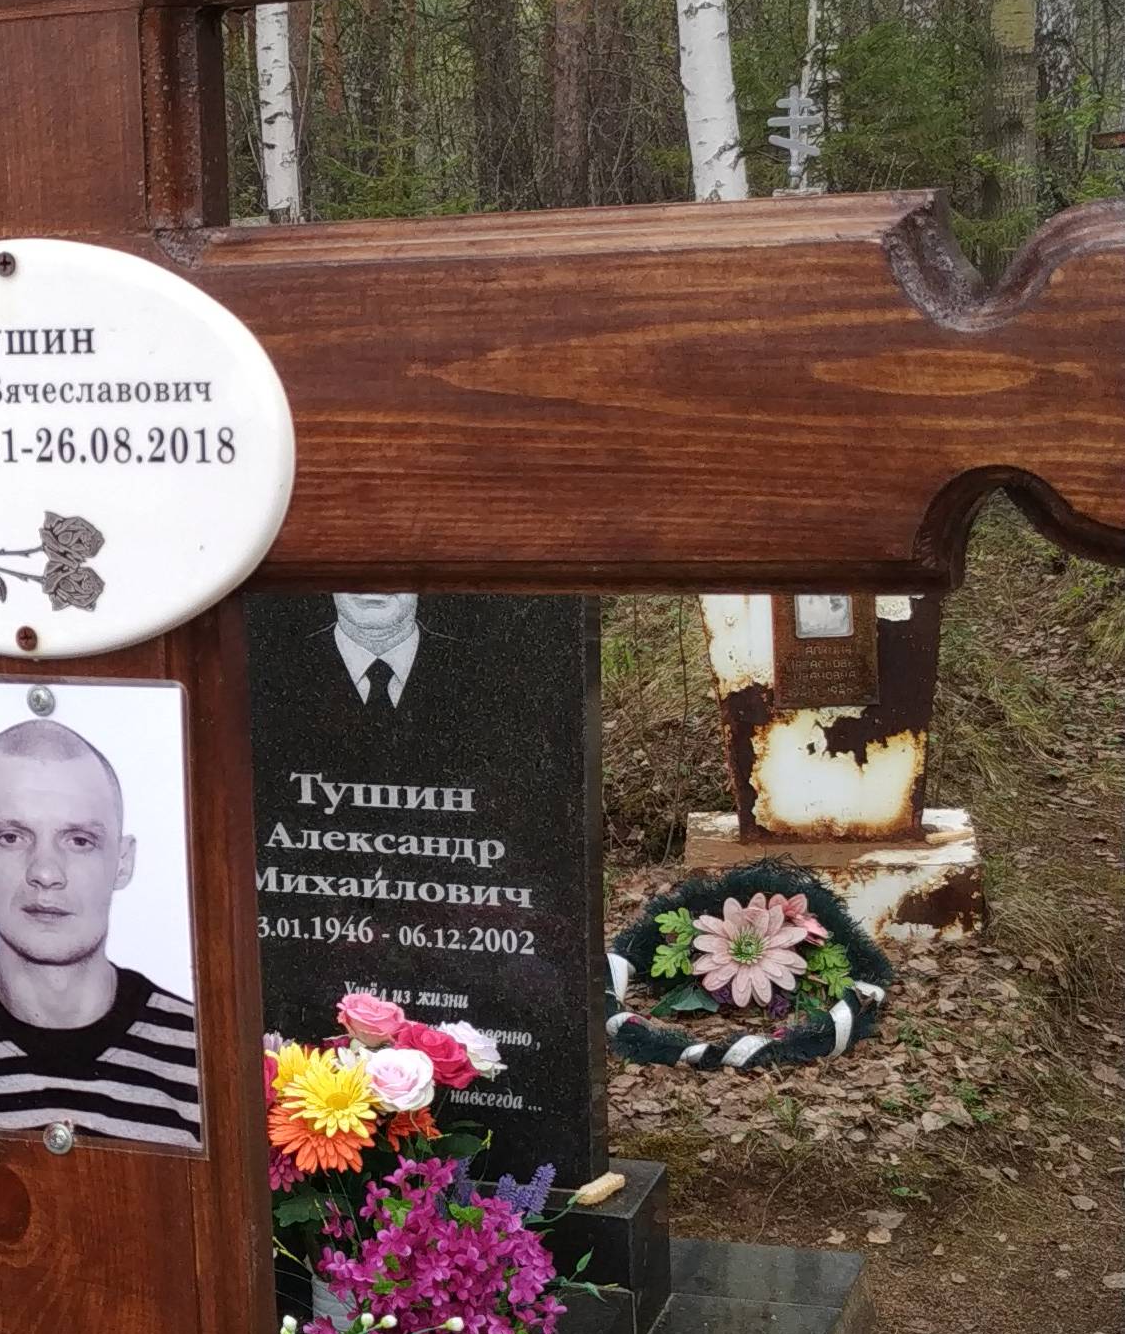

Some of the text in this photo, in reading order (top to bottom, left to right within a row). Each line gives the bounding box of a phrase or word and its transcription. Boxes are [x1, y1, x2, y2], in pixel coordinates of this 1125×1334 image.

[289, 771, 477, 815] Тушин
[265, 821, 506, 868] Александр
[256, 866, 534, 909] Михайлович
[257, 915, 374, 944] 3.01.1946
[399, 924, 535, 955] 06.12.2002
[392, 989, 411, 1004] из
[416, 991, 469, 1009] жизни
[450, 1087, 523, 1110] навсегда
